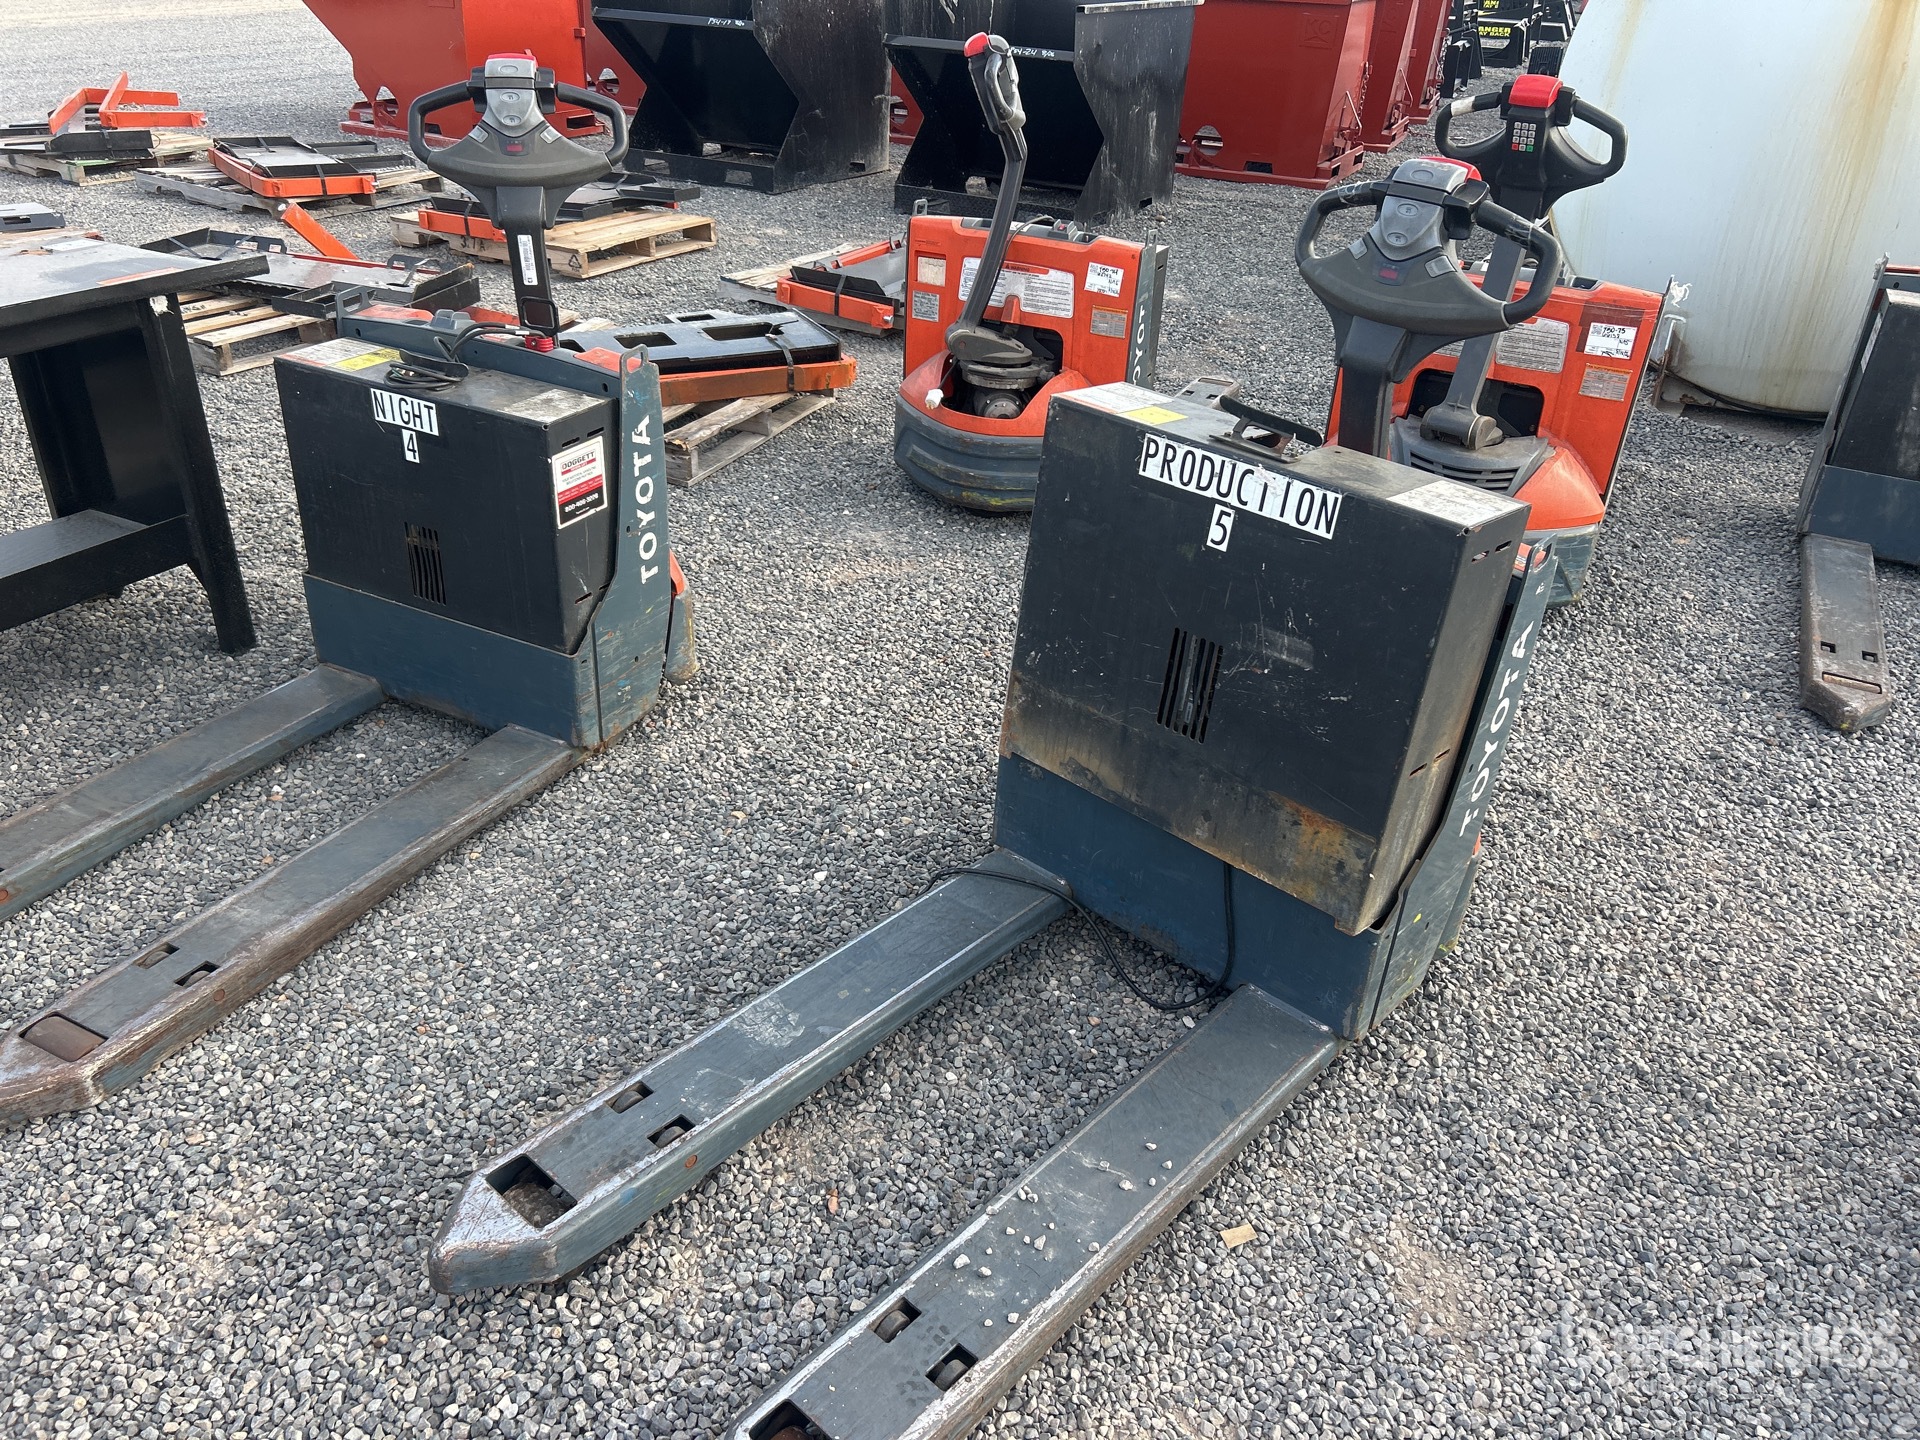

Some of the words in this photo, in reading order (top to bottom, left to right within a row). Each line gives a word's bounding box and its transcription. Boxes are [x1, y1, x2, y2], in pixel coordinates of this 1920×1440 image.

[1478, 26, 1511, 34] ANGER
[1133, 293, 1147, 386] OYOT
[373, 391, 433, 433] NIGHT
[407, 433, 417, 460] 4
[632, 415, 658, 584] TOYOTA
[1141, 437, 1340, 535] PRODUCTION
[1210, 510, 1232, 546] 5
[1459, 621, 1534, 837] TOYOTA
